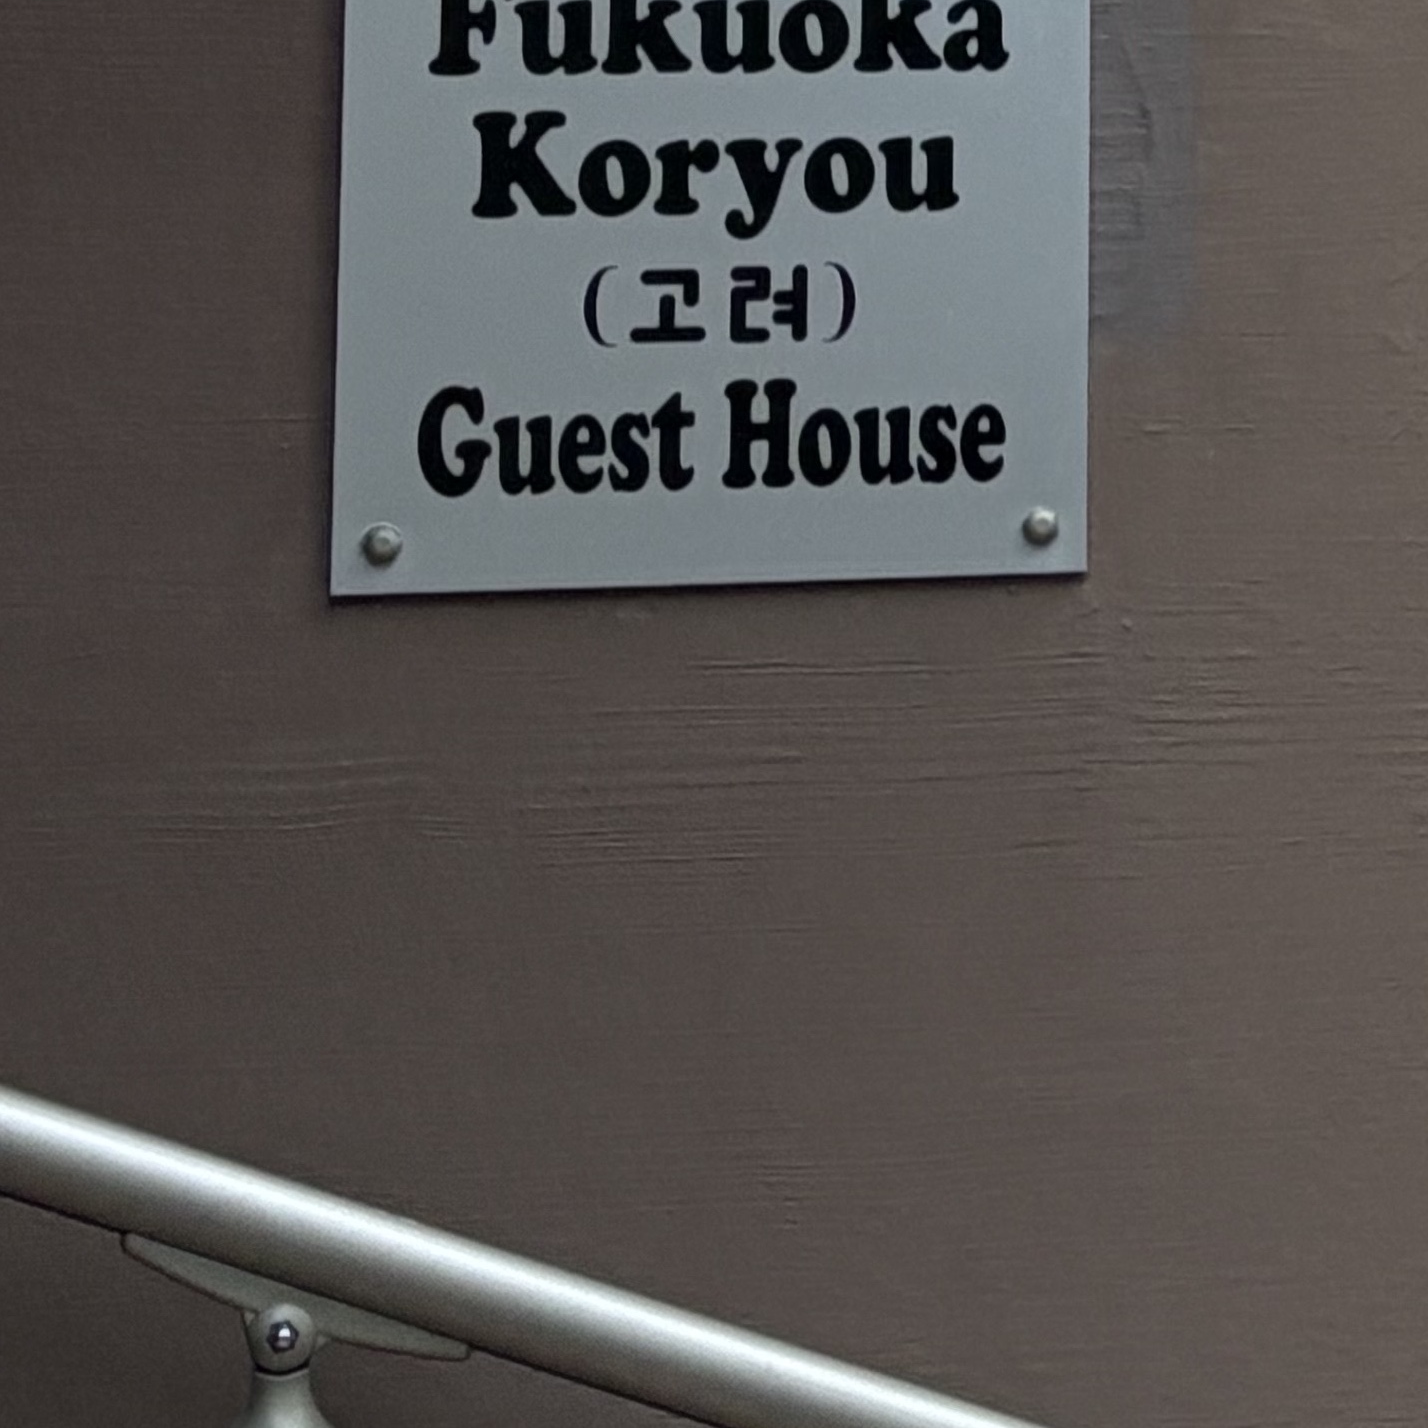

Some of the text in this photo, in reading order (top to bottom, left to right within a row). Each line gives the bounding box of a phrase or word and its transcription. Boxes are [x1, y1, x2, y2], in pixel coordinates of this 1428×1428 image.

[471, 110, 960, 240] Koryou
[416, 378, 1007, 498] Guest House
